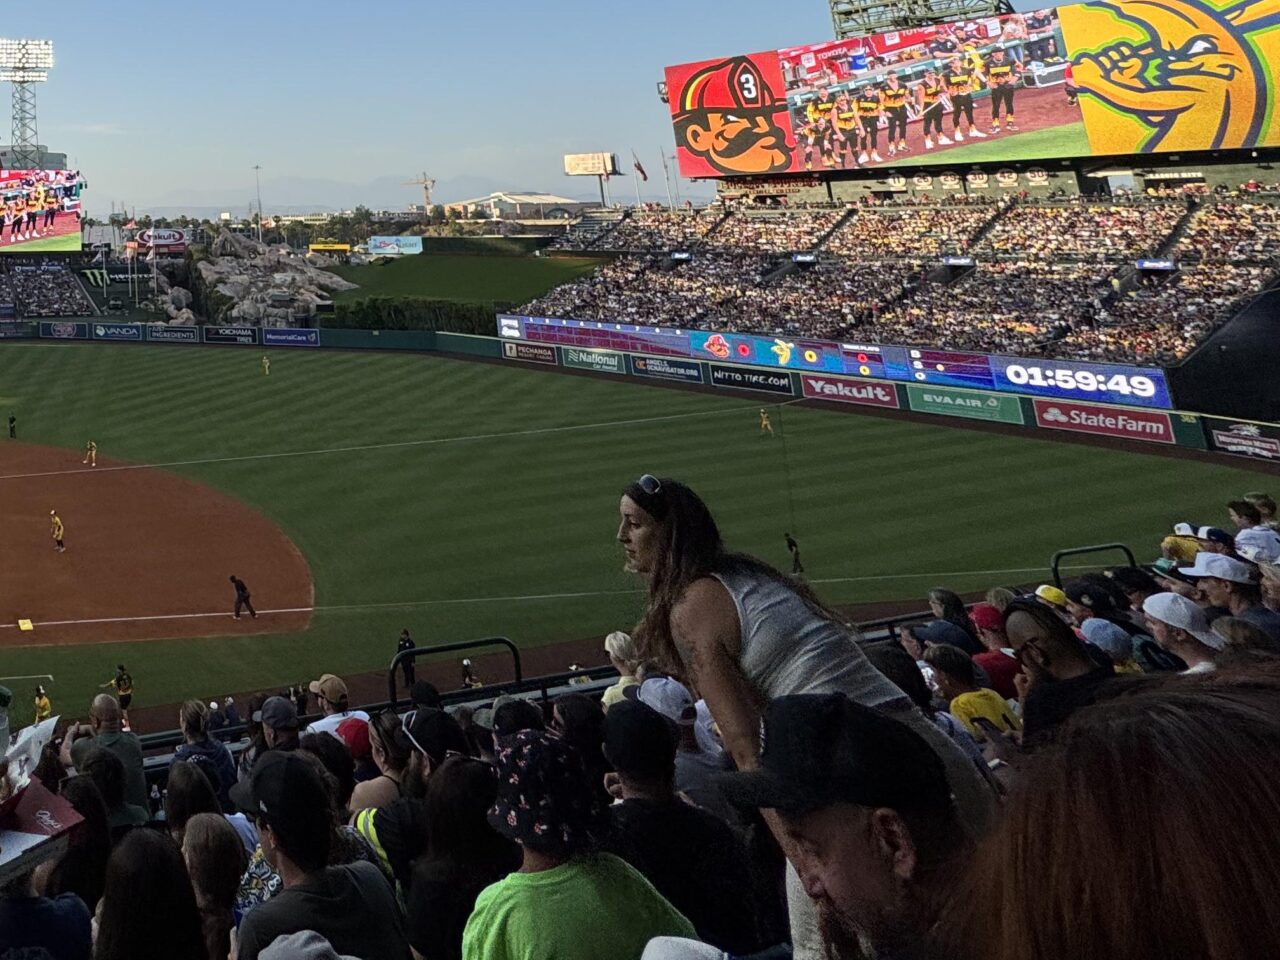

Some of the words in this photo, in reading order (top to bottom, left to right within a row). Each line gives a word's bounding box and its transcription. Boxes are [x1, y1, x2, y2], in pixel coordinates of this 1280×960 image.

[740, 73, 757, 99] 3
[105, 326, 138, 335] VANDA
[151, 331, 194, 339] INGREDIENTS
[218, 328, 252, 336] YOKOHAMA
[266, 332, 307, 341] MemorialCare
[517, 346, 552, 356] PECHANGA
[579, 352, 618, 367] National
[713, 370, 742, 382] NITTO
[744, 372, 789, 389] TIRE.COM
[1005, 364, 1156, 398] 01:59:49
[808, 379, 892, 402] Yakult
